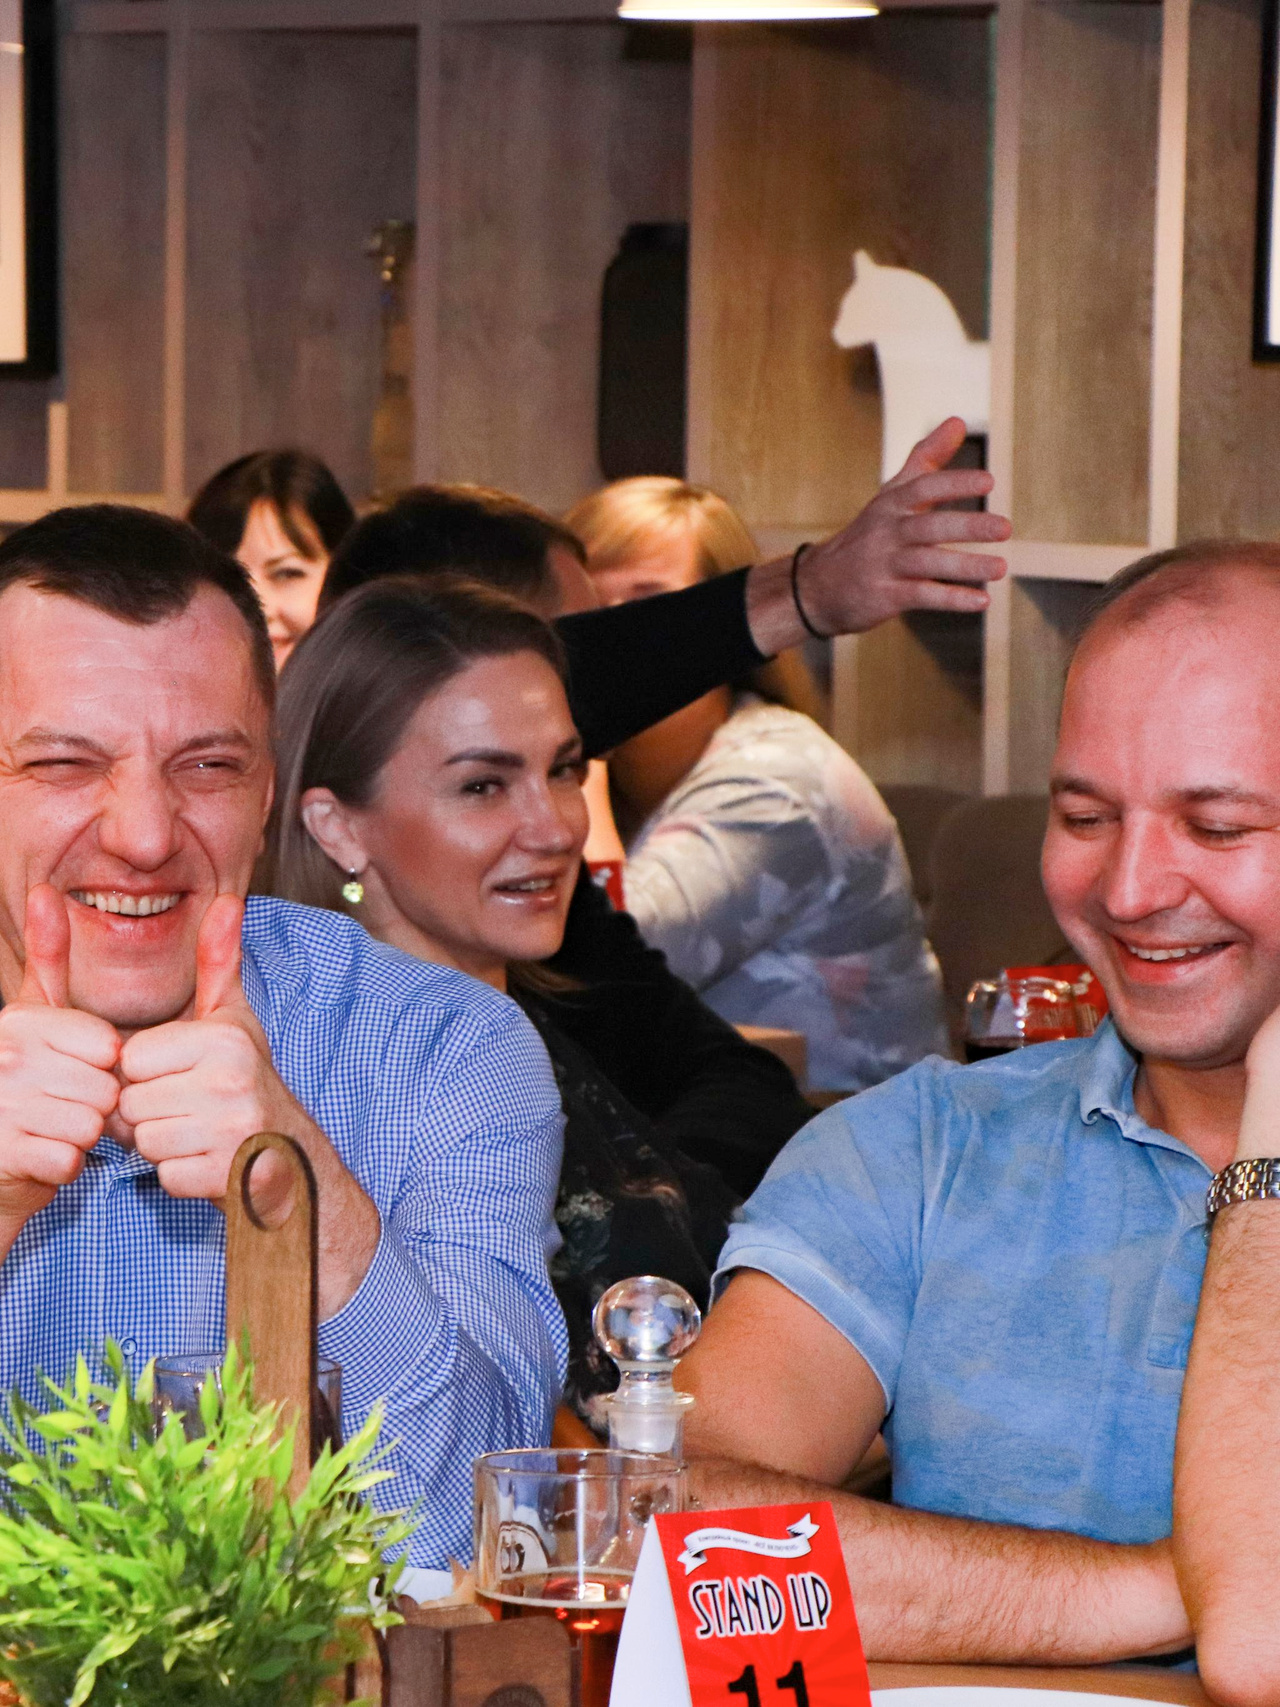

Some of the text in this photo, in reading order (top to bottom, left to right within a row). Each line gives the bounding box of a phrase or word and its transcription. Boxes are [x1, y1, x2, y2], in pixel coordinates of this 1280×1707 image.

[689, 1572, 832, 1639] STAND UP
[727, 1660, 810, 1707] 11
